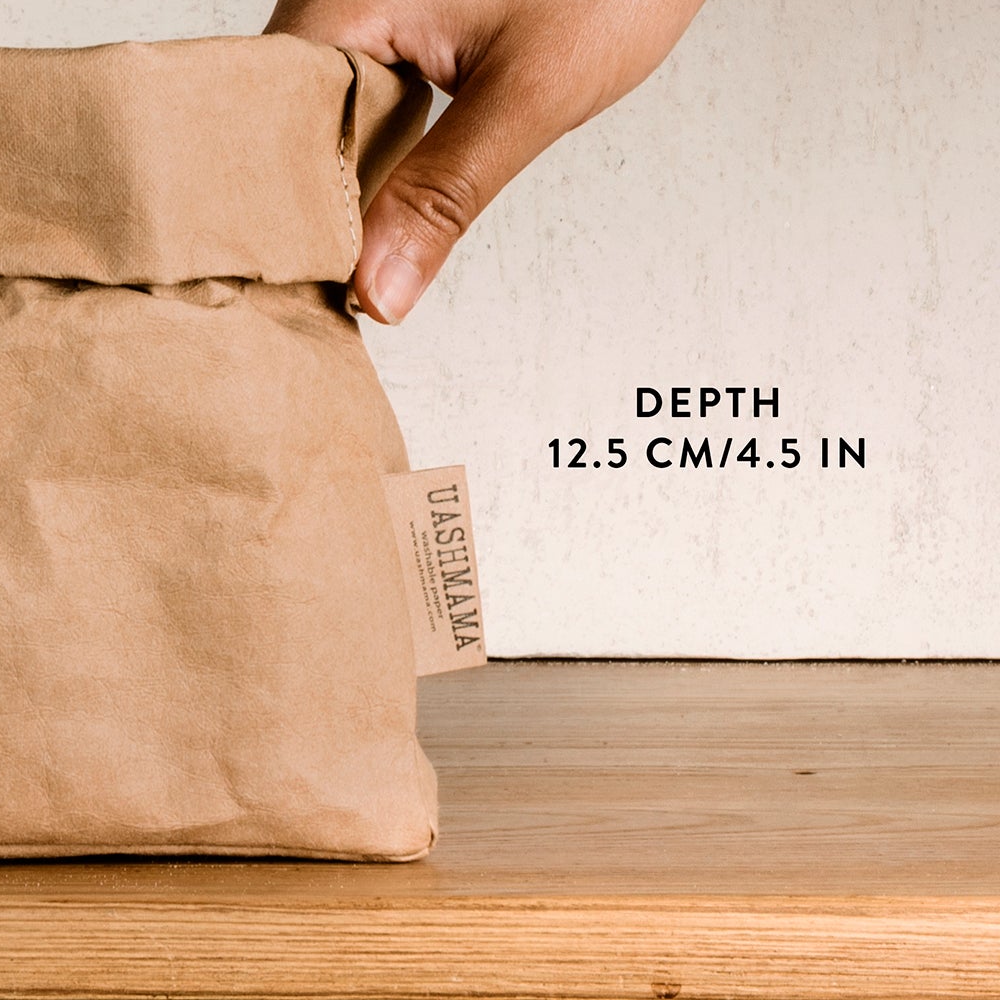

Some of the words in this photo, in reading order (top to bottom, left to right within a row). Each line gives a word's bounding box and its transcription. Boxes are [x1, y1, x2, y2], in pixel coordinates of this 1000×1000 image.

[409, 520, 437, 633] www.uashmama.com
[421, 530, 436, 584] washable
[430, 586, 444, 619] paper
